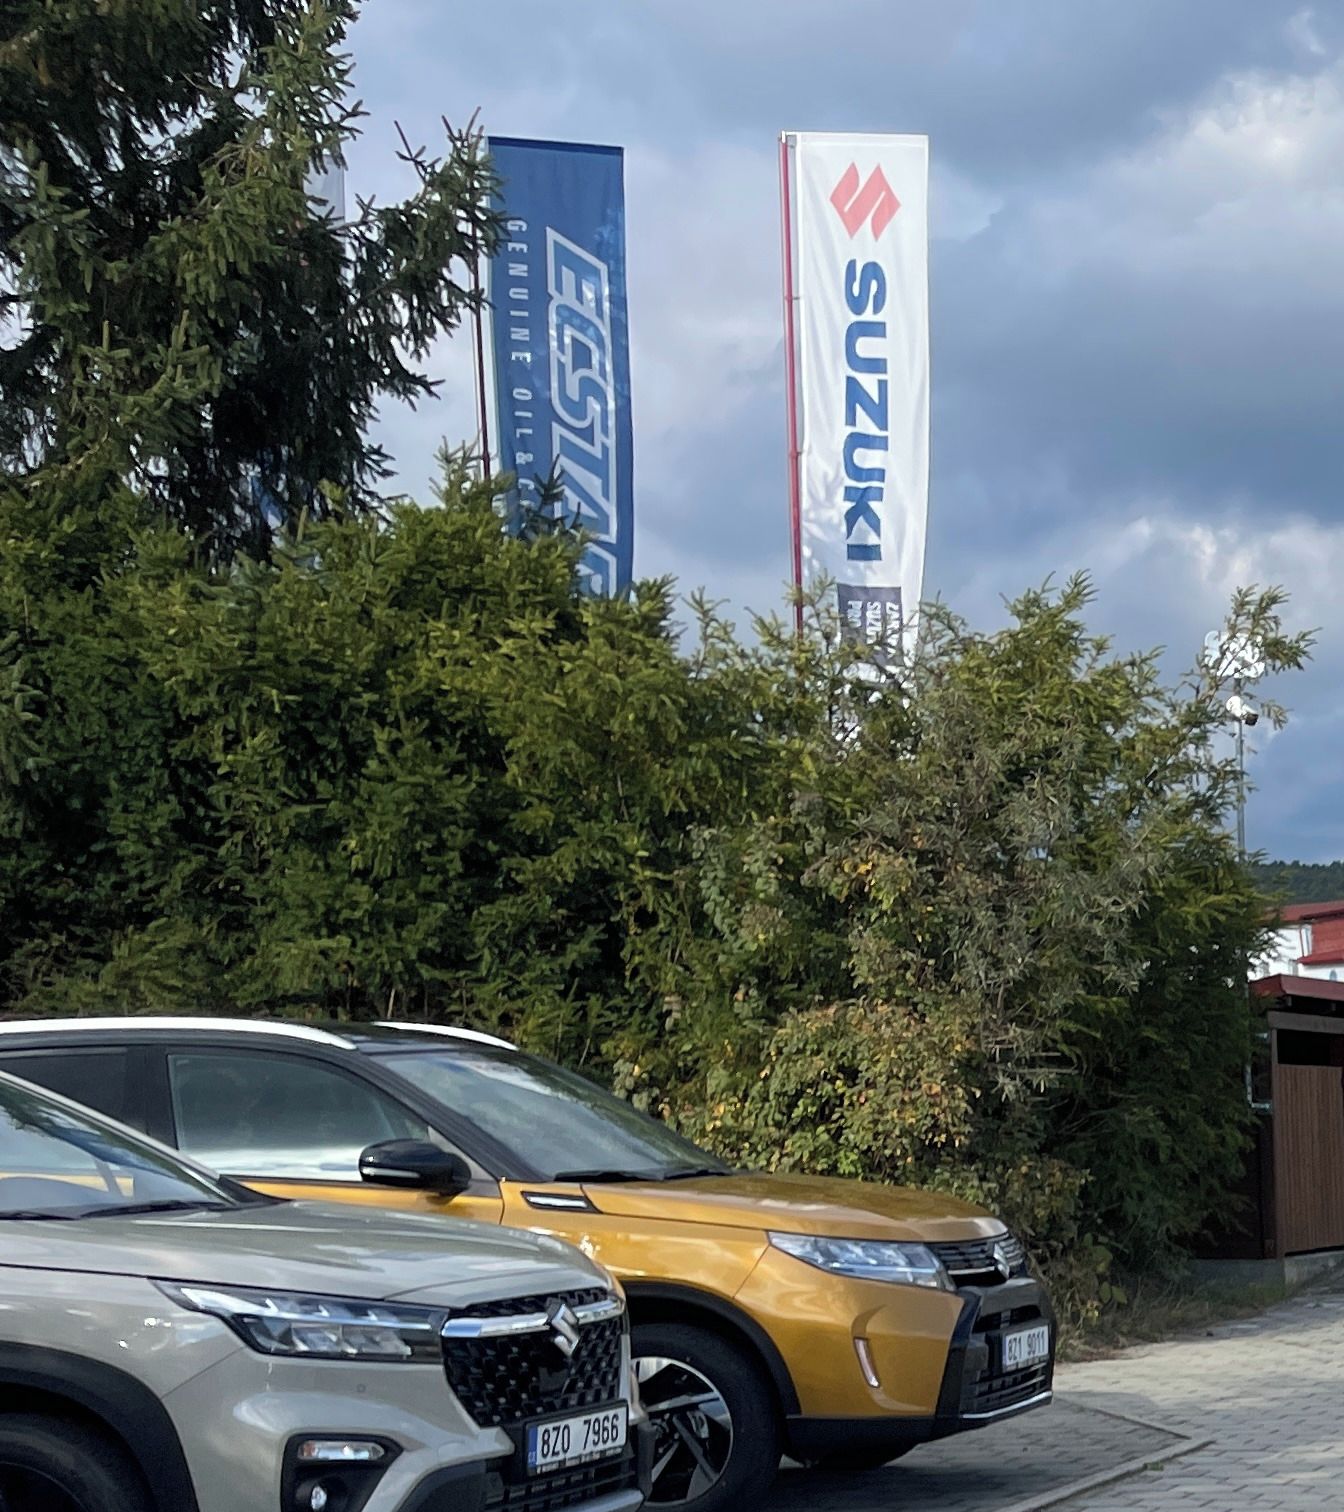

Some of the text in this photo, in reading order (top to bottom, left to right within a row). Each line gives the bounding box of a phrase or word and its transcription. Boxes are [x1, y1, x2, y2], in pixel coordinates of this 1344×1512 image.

[506, 219, 532, 363] GENUINE
[843, 258, 889, 561] SUZUKI
[582, 1413, 620, 1451] 7966
